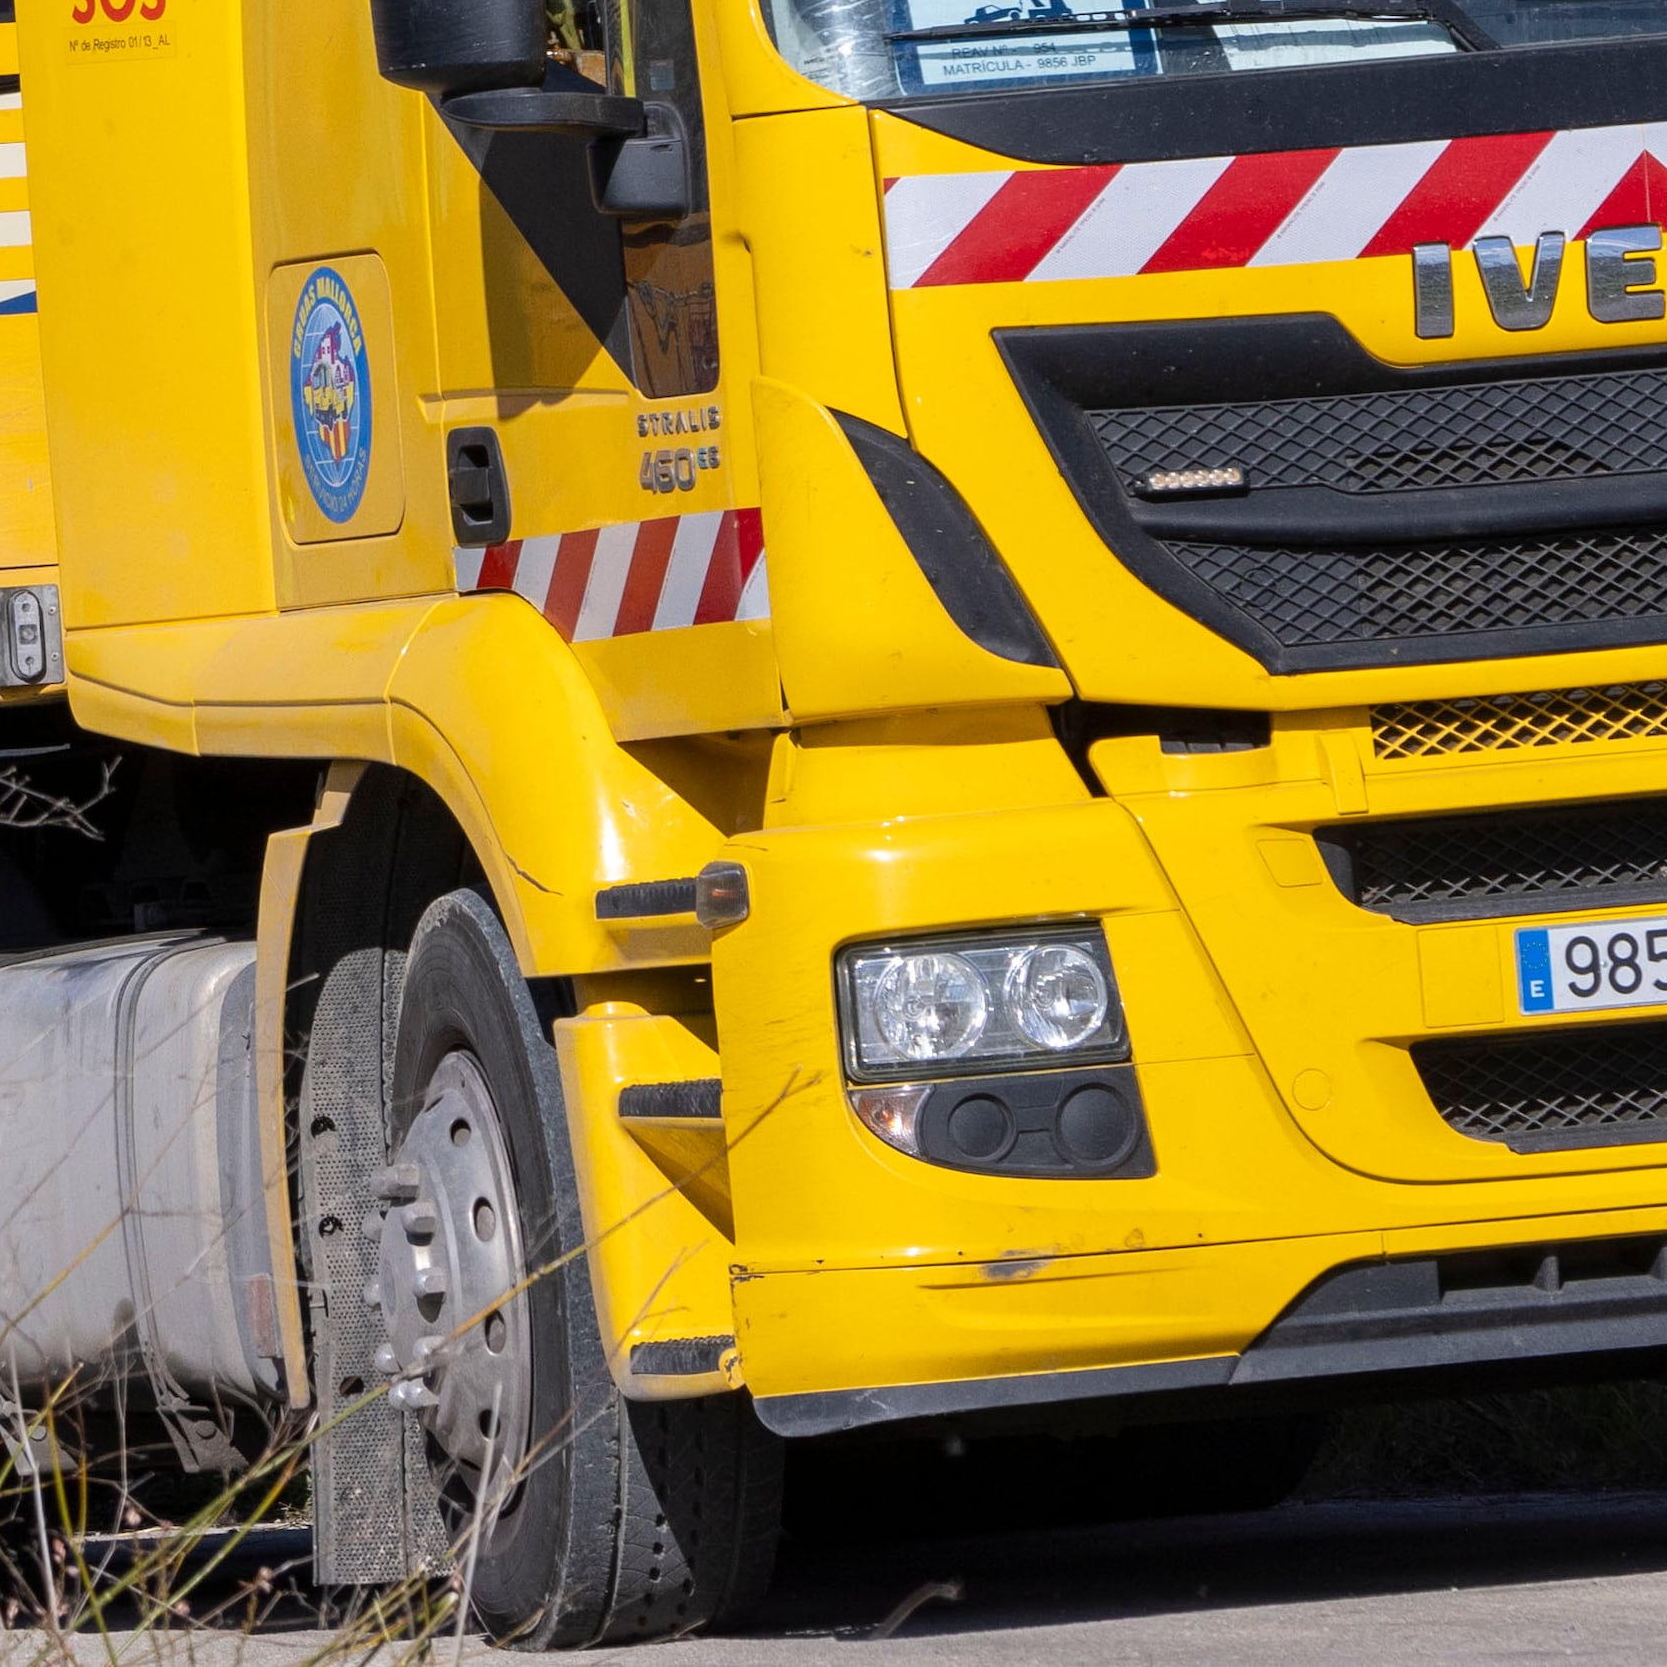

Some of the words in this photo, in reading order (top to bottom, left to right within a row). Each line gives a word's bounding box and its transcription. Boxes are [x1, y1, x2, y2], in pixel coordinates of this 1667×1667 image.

[81, 40, 91, 51] de
[93, 38, 126, 52] Registro
[952, 47, 988, 59] REAV
[1033, 42, 1056, 54] 954
[943, 60, 1024, 76] MATRÍCULA
[1037, 57, 1067, 69] 9856
[1071, 55, 1096, 67] JBP
[1412, 222, 1666, 340] IVE
[316, 276, 361, 356] MALLORCA
[637, 406, 720, 437] STRALIS
[639, 447, 696, 494] 460
[1530, 979, 1545, 998] E
